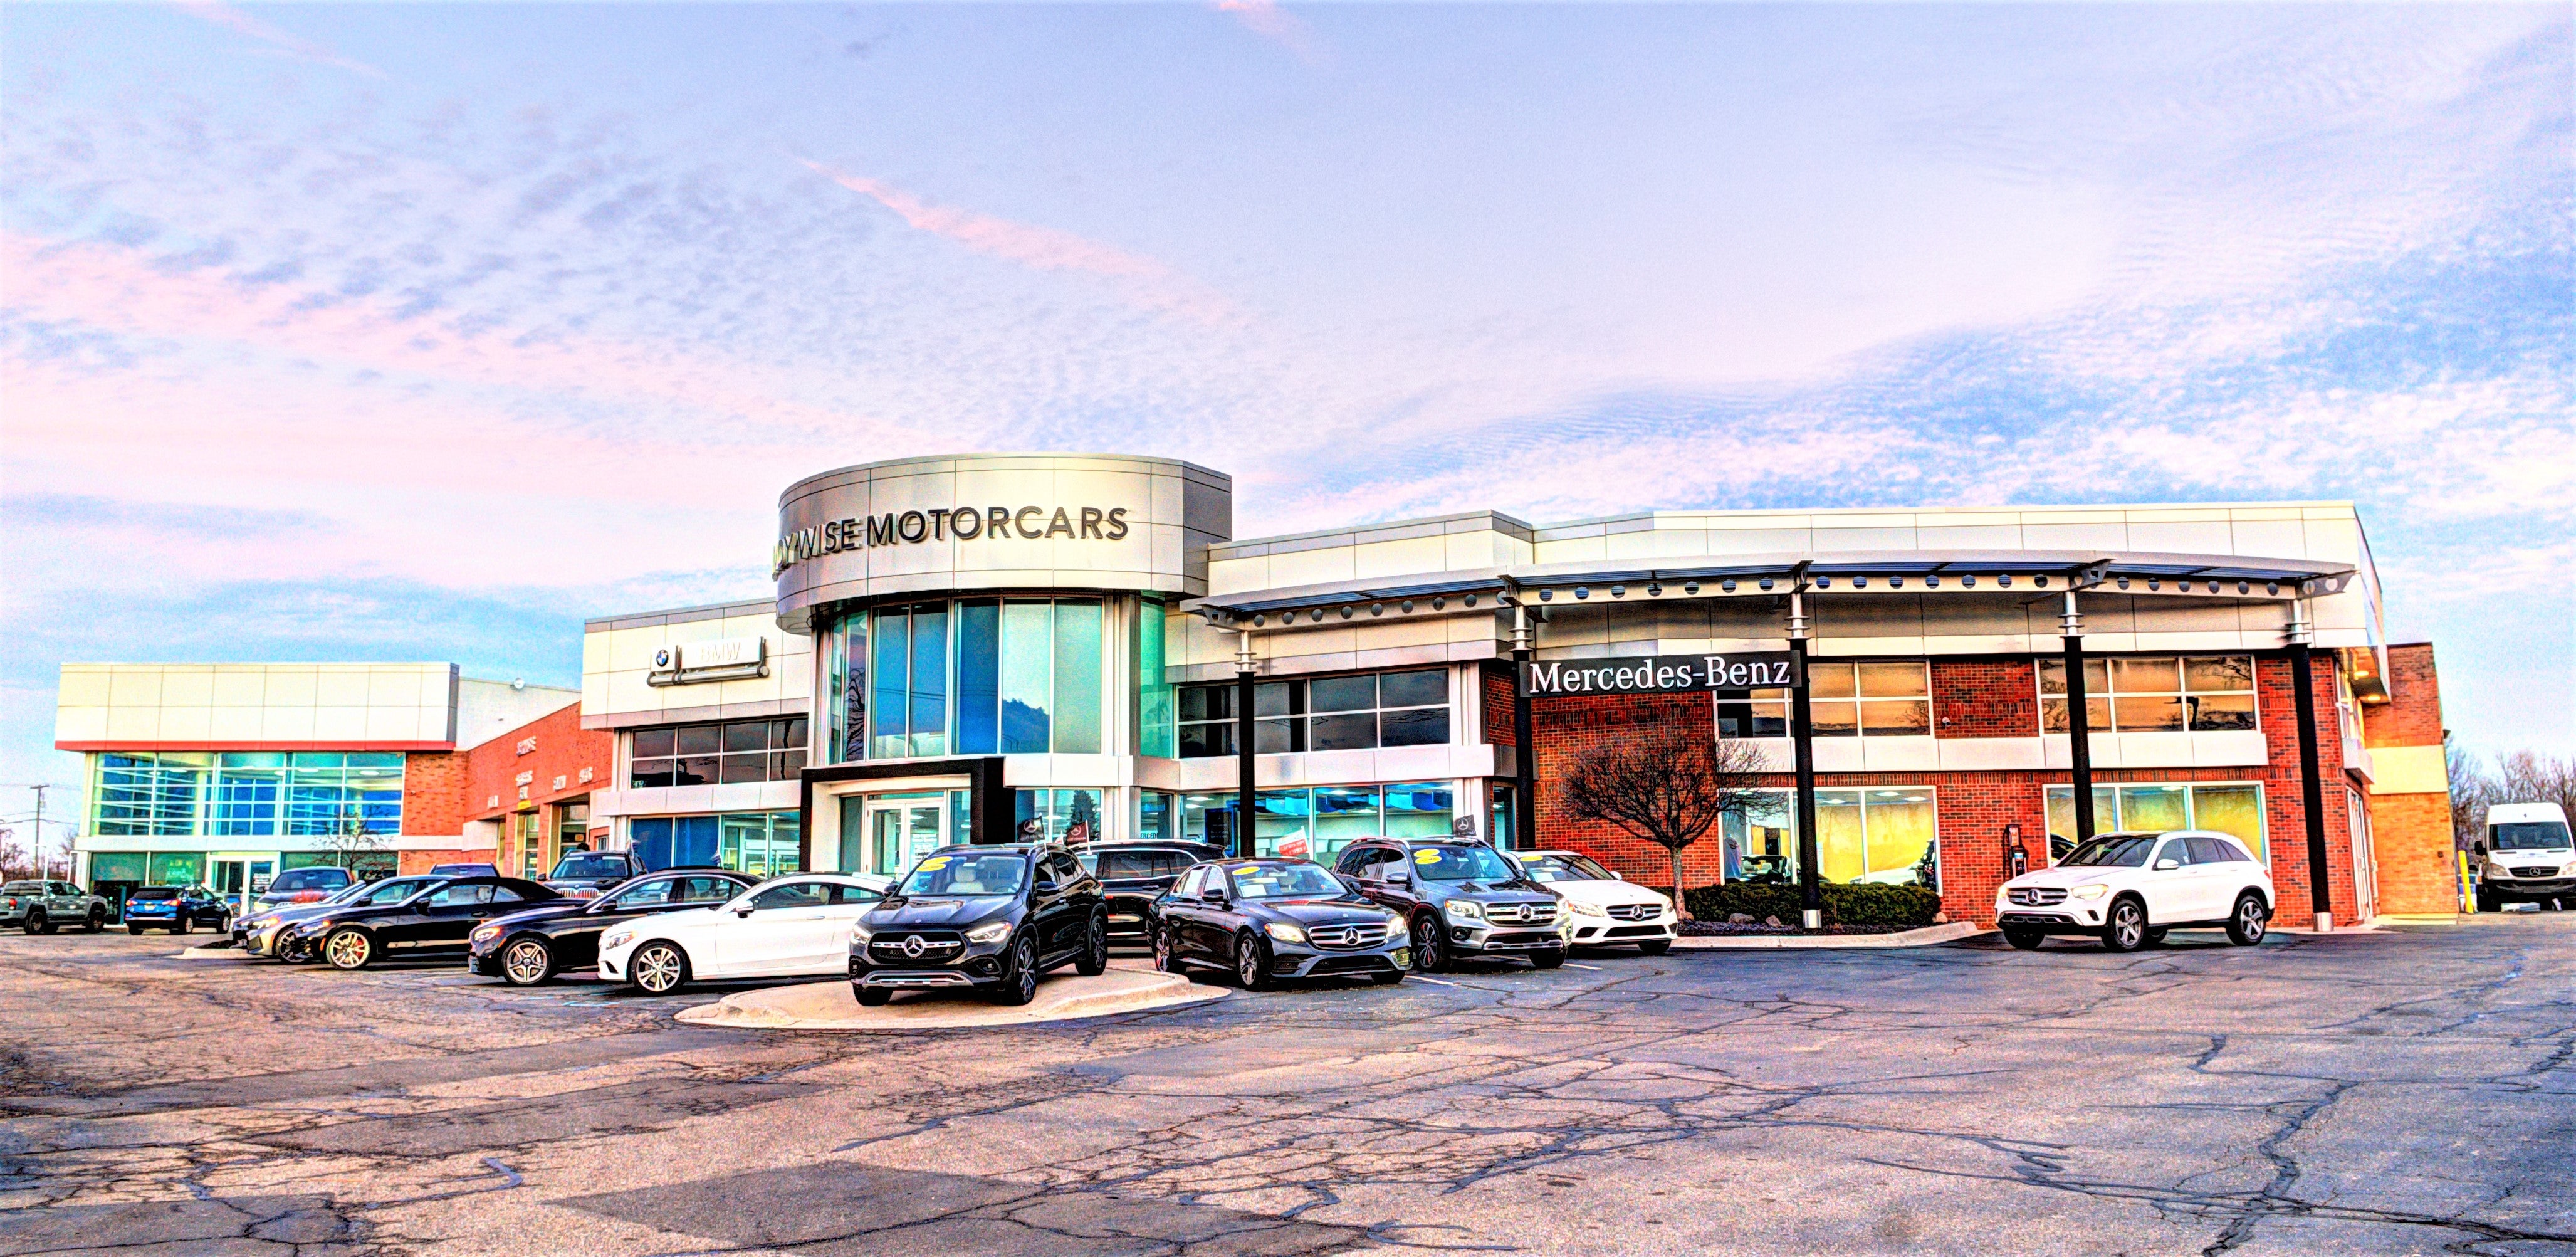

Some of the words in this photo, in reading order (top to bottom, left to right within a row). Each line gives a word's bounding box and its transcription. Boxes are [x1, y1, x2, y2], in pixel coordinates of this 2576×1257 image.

[866, 506, 1129, 546] MOTORCARS
[701, 641, 740, 662] BMW
[1529, 656, 1791, 693] Mercedes-Benz
